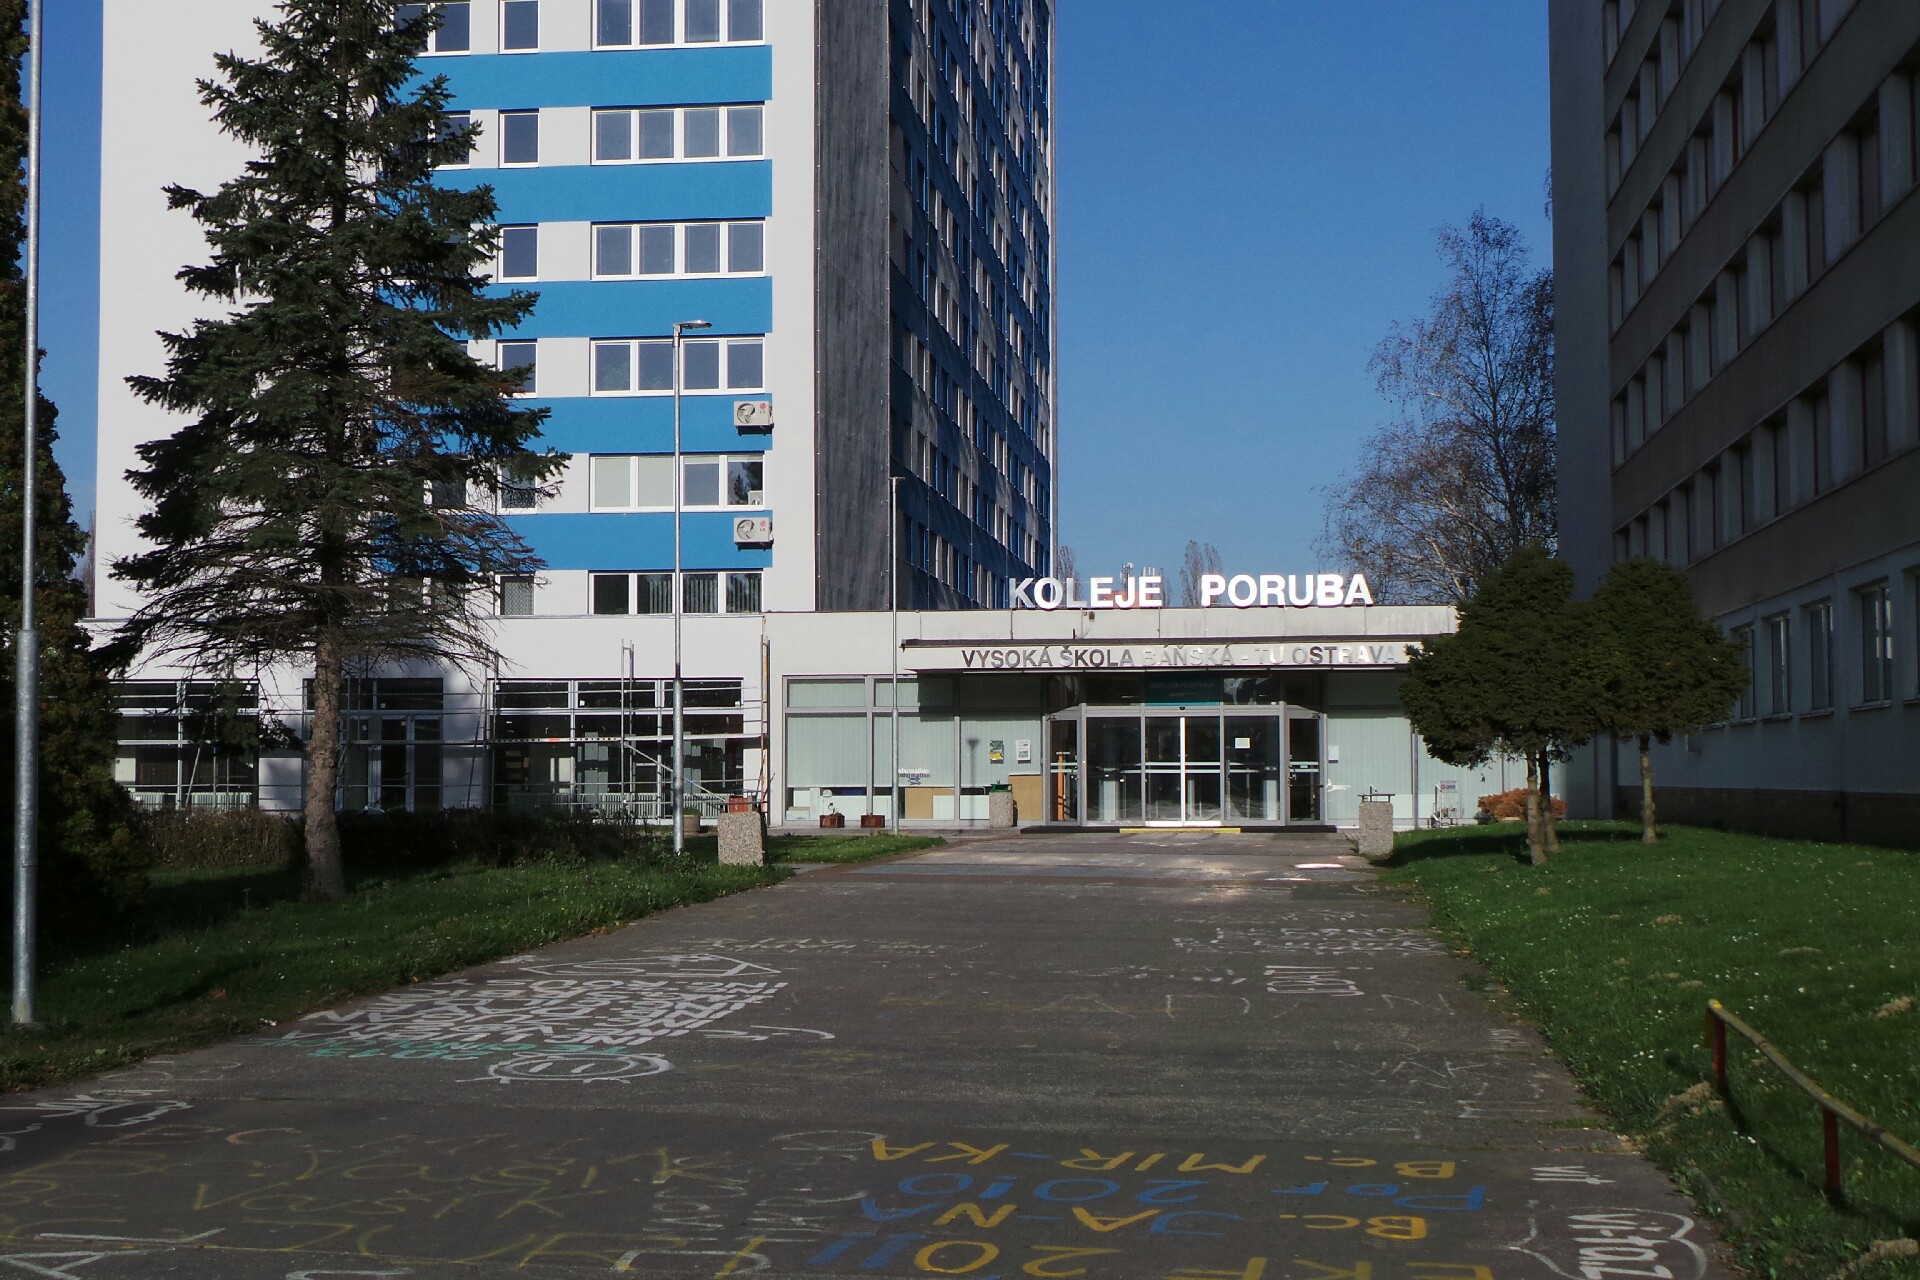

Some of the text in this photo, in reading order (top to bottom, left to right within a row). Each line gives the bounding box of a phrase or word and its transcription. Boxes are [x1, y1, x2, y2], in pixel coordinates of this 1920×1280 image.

[1009, 574, 1374, 610] KOLEJE PORUBA
[962, 645, 1053, 668] VYSOKÁ
[1059, 645, 1135, 668] ŠKOLA
[1142, 643, 1235, 667] BÁŇSKÁ
[1291, 645, 1399, 665] OSTRAVA
